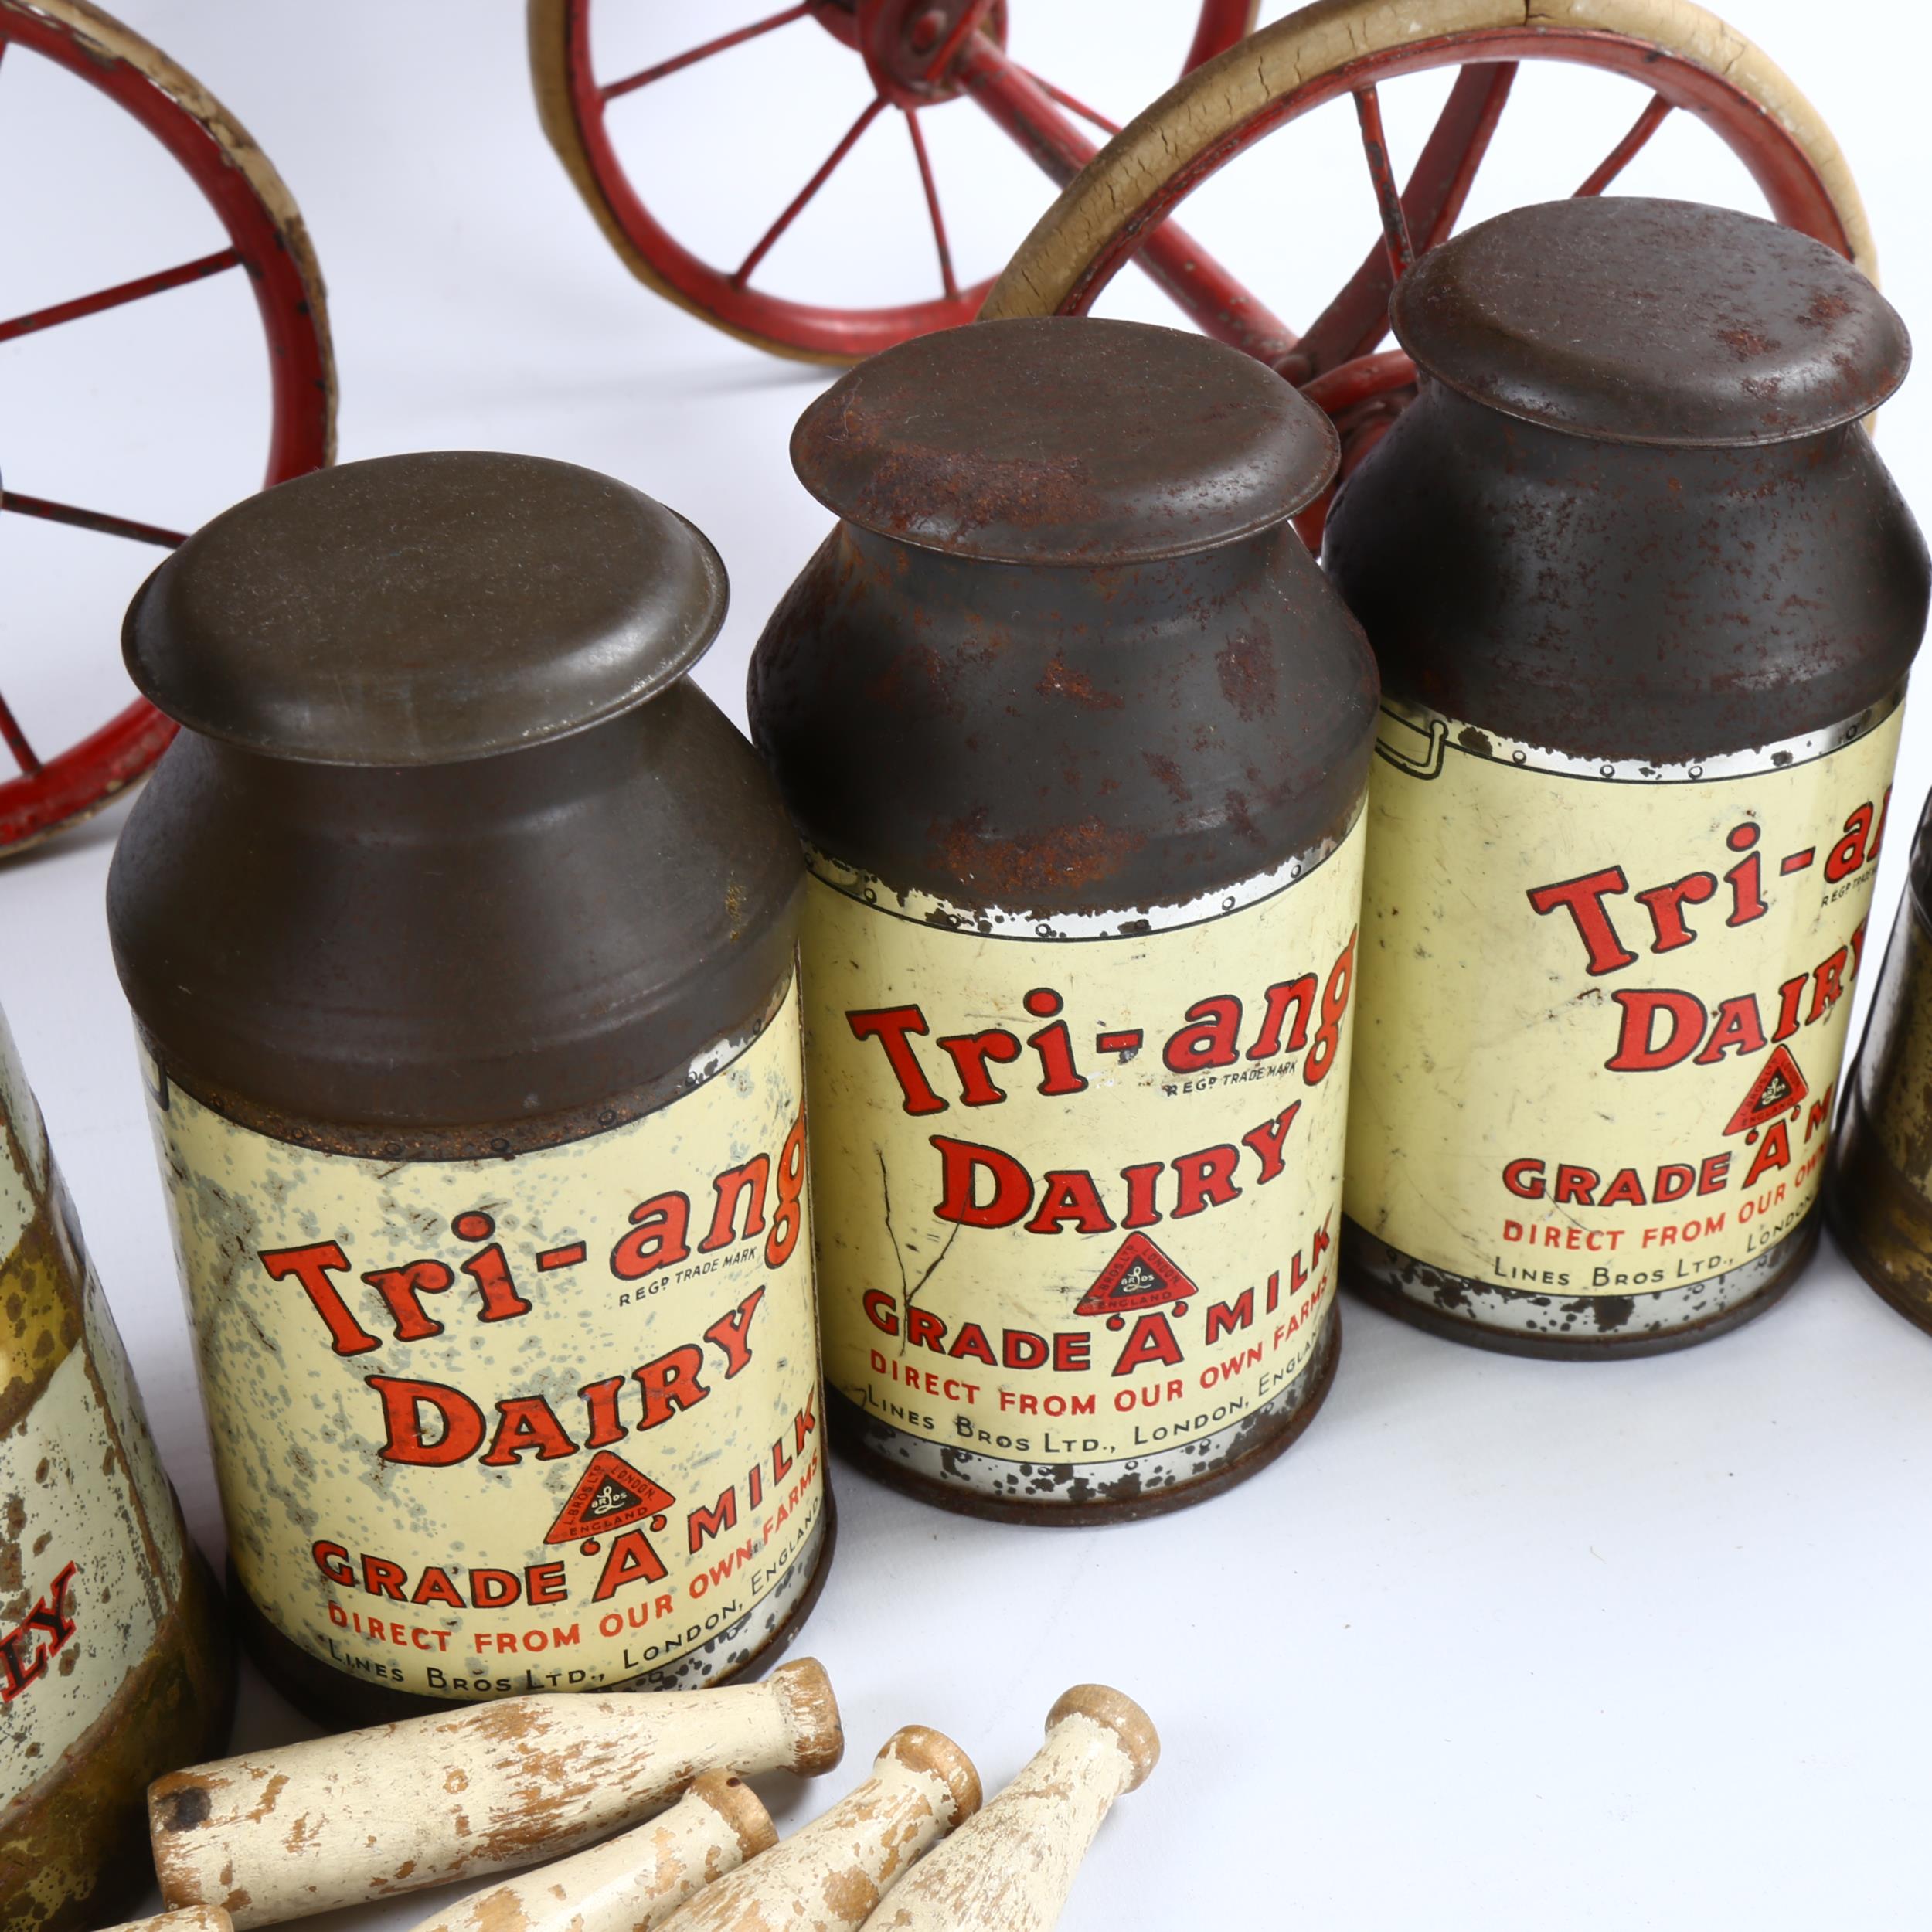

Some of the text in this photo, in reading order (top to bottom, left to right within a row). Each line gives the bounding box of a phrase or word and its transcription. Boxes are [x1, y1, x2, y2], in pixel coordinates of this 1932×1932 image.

[1223, 1067, 1266, 1086] TRADE
[1267, 1060, 1298, 1077] MARK
[929, 1100, 1302, 1234] DAIRY
[1502, 1151, 1732, 1207] GRADE
[1502, 1219, 1624, 1251] DIRECT
[1641, 1213, 1726, 1249] FROM
[1738, 1182, 1786, 1224] OUR
[675, 1258, 720, 1284] TRADE
[722, 1246, 757, 1269] MARK
[862, 1288, 1091, 1372] GRADE
[1205, 1203, 1330, 1345] MILK
[1495, 1257, 1570, 1287] LINES
[1592, 1266, 1665, 1287] BROS
[365, 1285, 765, 1467] DAIRY
[870, 1270, 1328, 1415] DIRECT FROM OUR OWN FARMS
[866, 1384, 934, 1430] LINES
[957, 1416, 1029, 1452] BROS
[1134, 1394, 1250, 1446] LONDON,
[311, 1539, 569, 1608] GRADE
[687, 1380, 816, 1555] MILK
[570, 1506, 648, 1536] ENGLAND
[328, 1447, 818, 1654] DIRECT FROM OUR OWN FARMS
[328, 1638, 405, 1683] LINES
[427, 1666, 512, 1692] BROS
[623, 1599, 744, 1671] LONDON,
